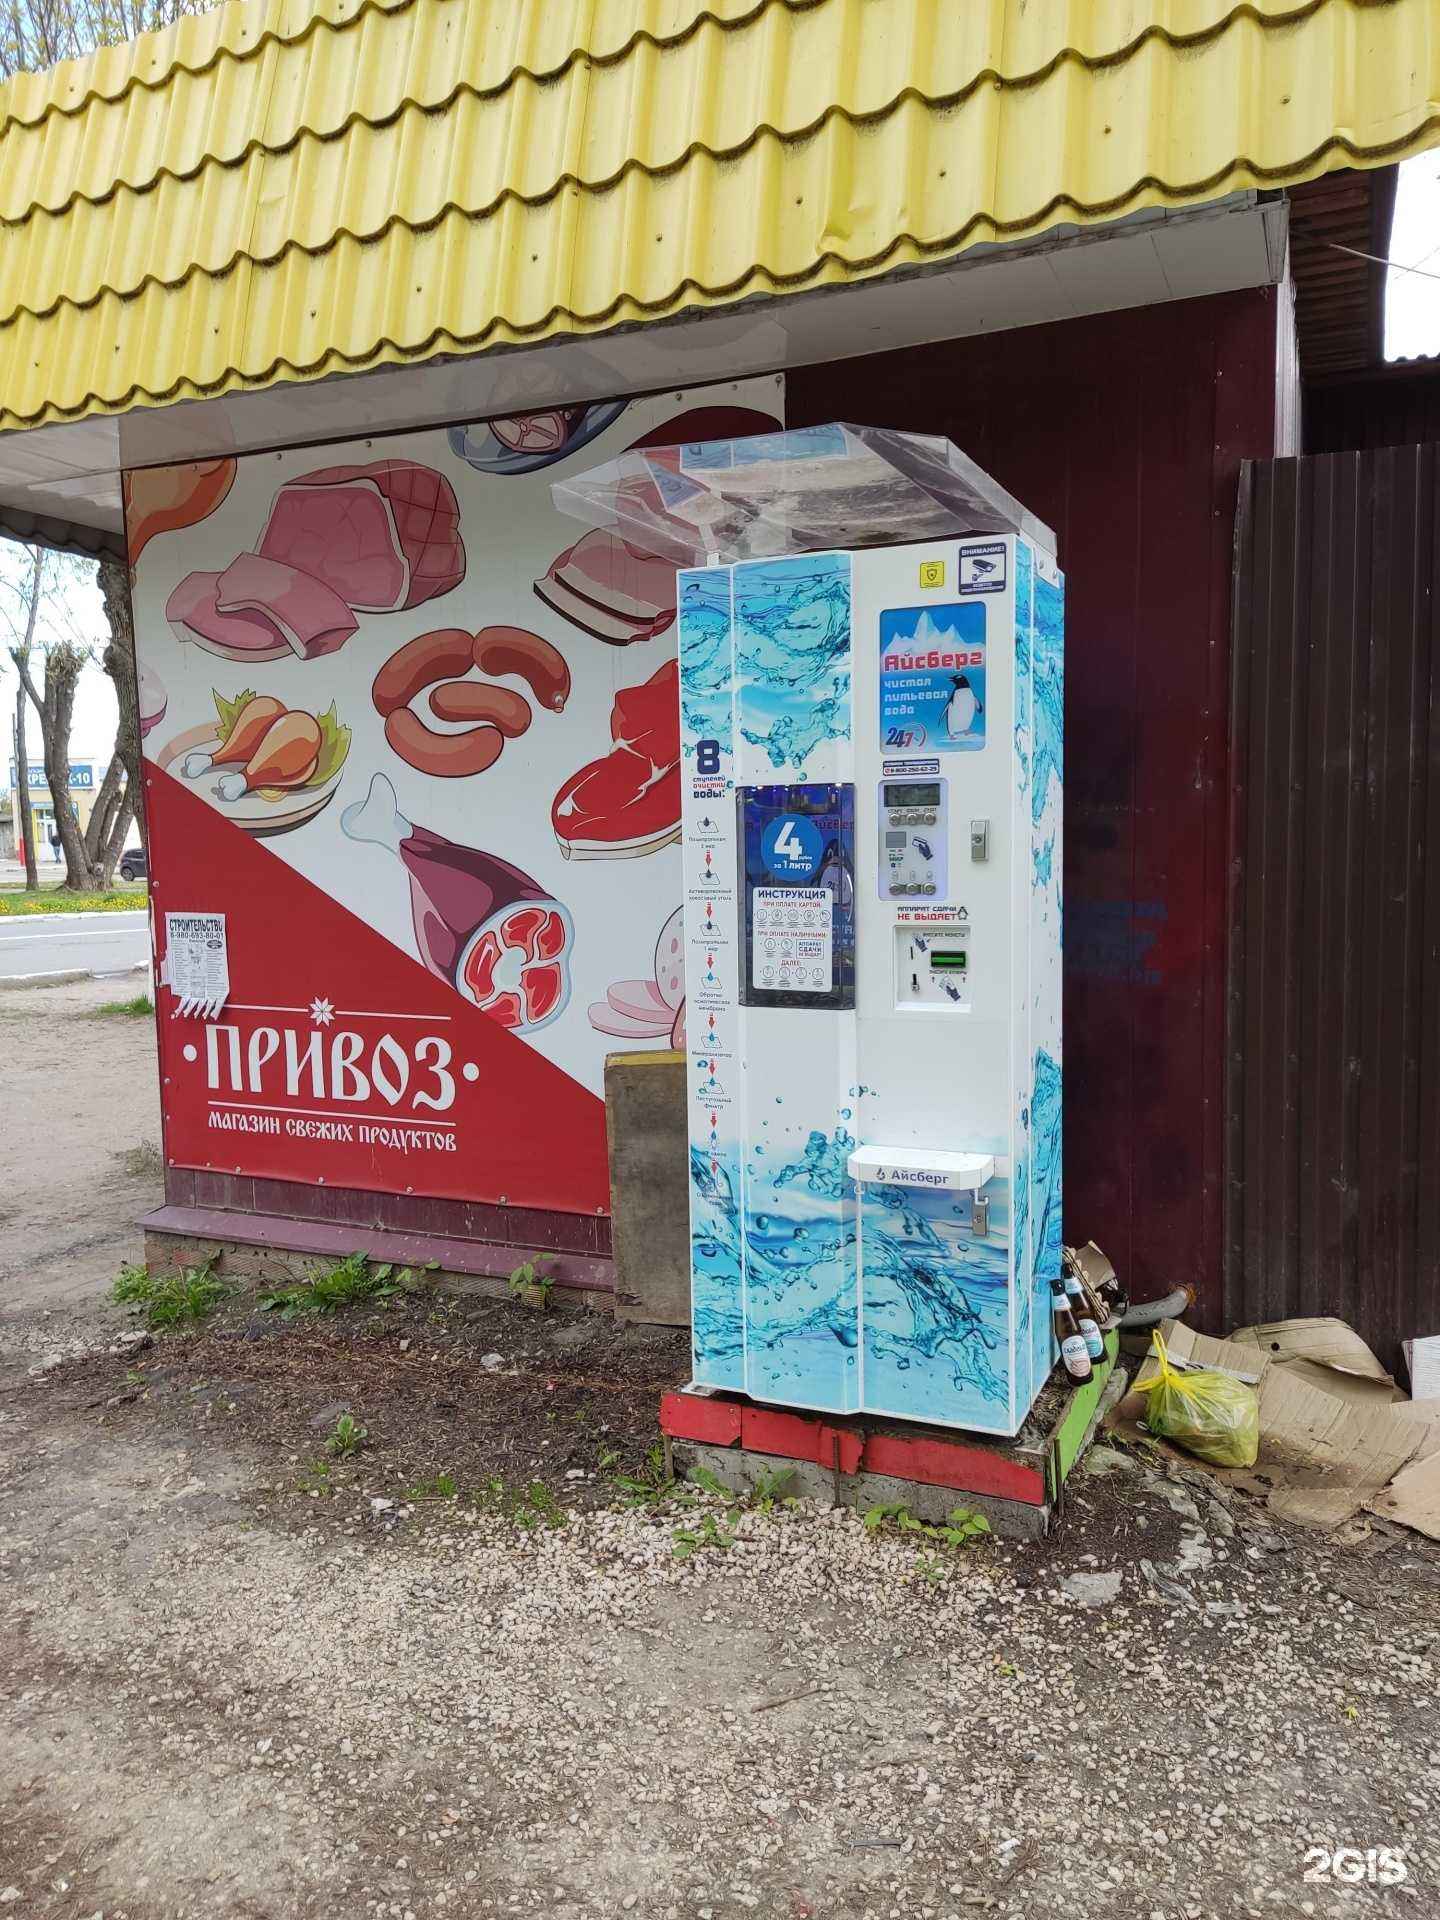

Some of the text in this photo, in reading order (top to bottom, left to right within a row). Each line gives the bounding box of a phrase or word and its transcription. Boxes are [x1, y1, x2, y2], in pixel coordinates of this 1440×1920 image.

[884, 651, 982, 671] Айсберг
[884, 678, 932, 688] чистая
[884, 690, 948, 702] питьевая
[884, 705, 915, 716] вода
[696, 740, 720, 774] 8
[693, 789, 726, 798] воды:
[774, 821, 803, 860] 4
[788, 862, 812, 871] литр
[758, 889, 826, 900] ИНСТРУКЦИЯ
[205, 1024, 456, 1111] ПРИВОЗ
[208, 1111, 457, 1155] МАГАЗИН СВЕЖИХ ПРОДУКТОВ
[891, 1170, 949, 1185] Айсберг
